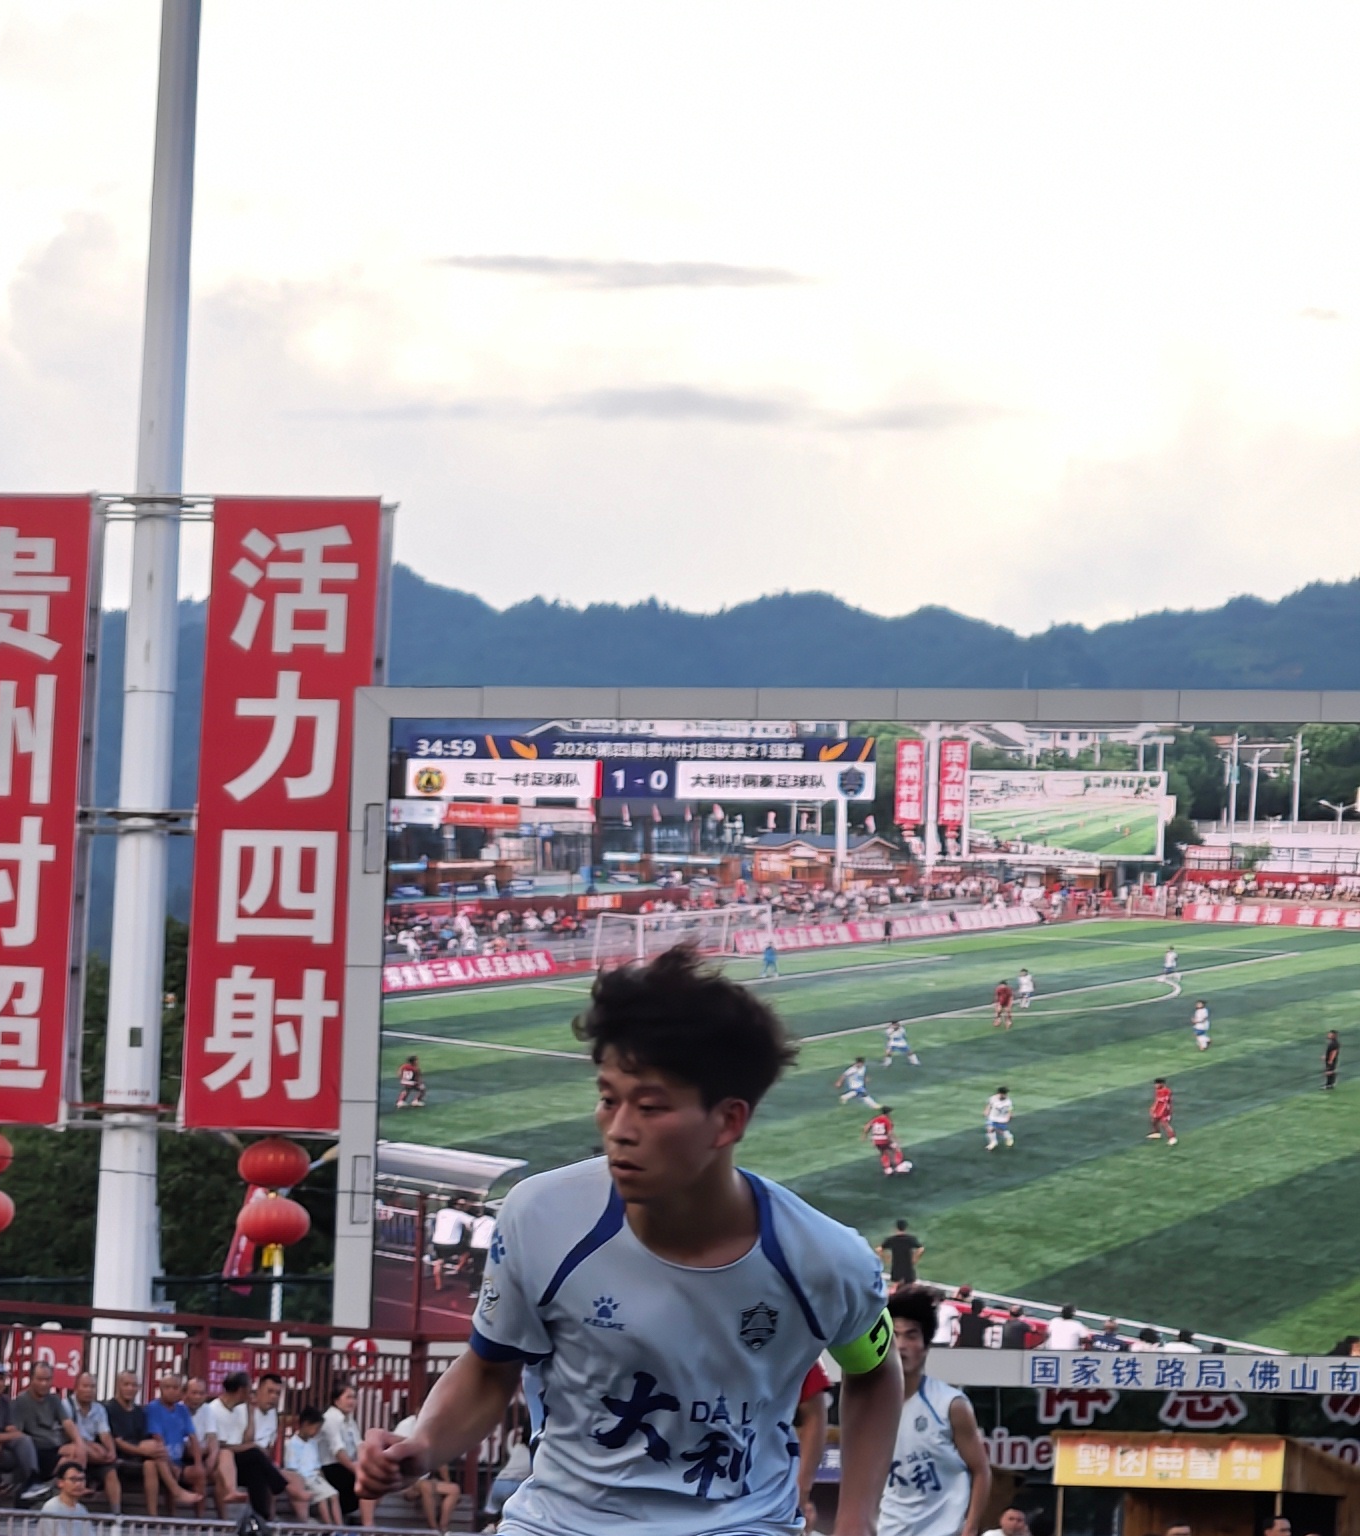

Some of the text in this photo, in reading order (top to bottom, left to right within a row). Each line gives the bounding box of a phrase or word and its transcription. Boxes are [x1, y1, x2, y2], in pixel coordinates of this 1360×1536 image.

[415, 740, 477, 757] 34:59
[611, 769, 625, 791] 1
[649, 768, 668, 790] 0
[202, 524, 360, 1100] 活力四射
[583, 1317, 626, 1331] KELME
[37, 1346, 80, 1377] D-3
[1031, 1355, 1360, 1393] 国家铁路局、佛山南
[587, 1371, 758, 1500] 大利
